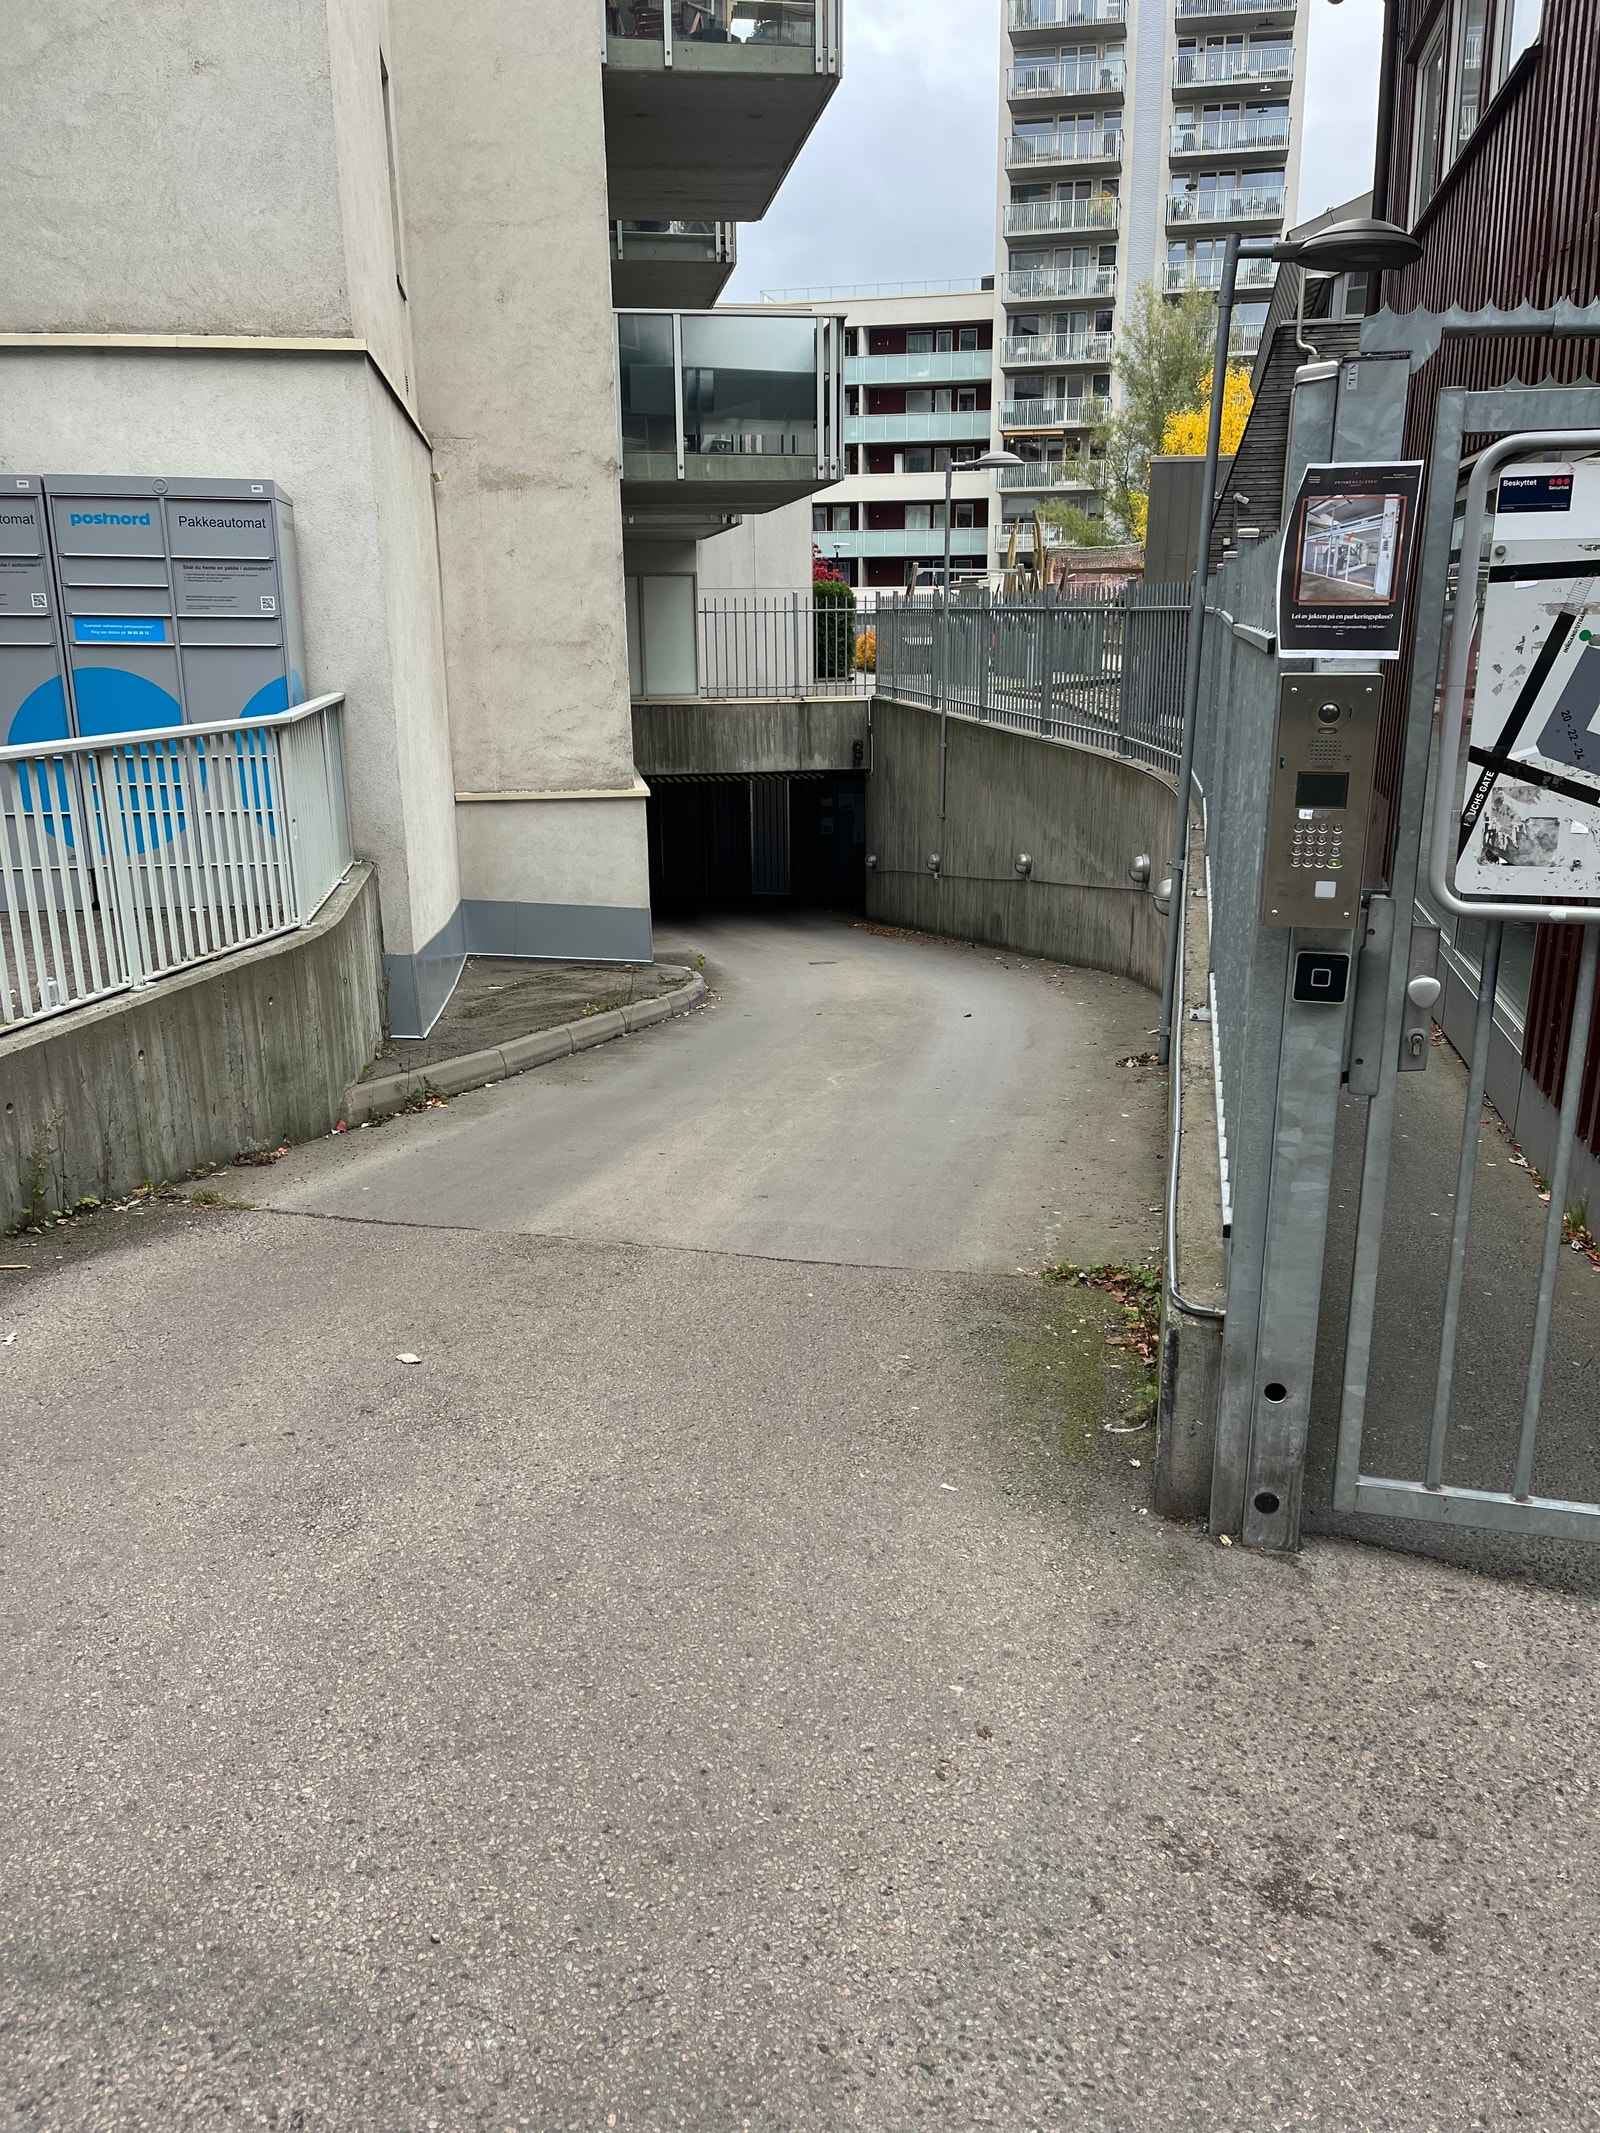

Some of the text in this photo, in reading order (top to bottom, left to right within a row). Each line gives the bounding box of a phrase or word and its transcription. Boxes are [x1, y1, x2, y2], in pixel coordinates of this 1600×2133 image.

[1503, 479, 1537, 487] Beskyttet
[70, 512, 151, 527] postnord
[178, 515, 267, 529] Pakkeautomat
[1561, 710, 1572, 722] 20
[1567, 729, 1579, 741] 22
[1574, 748, 1585, 760] 24
[1463, 770, 1495, 827] UCHS GATE
